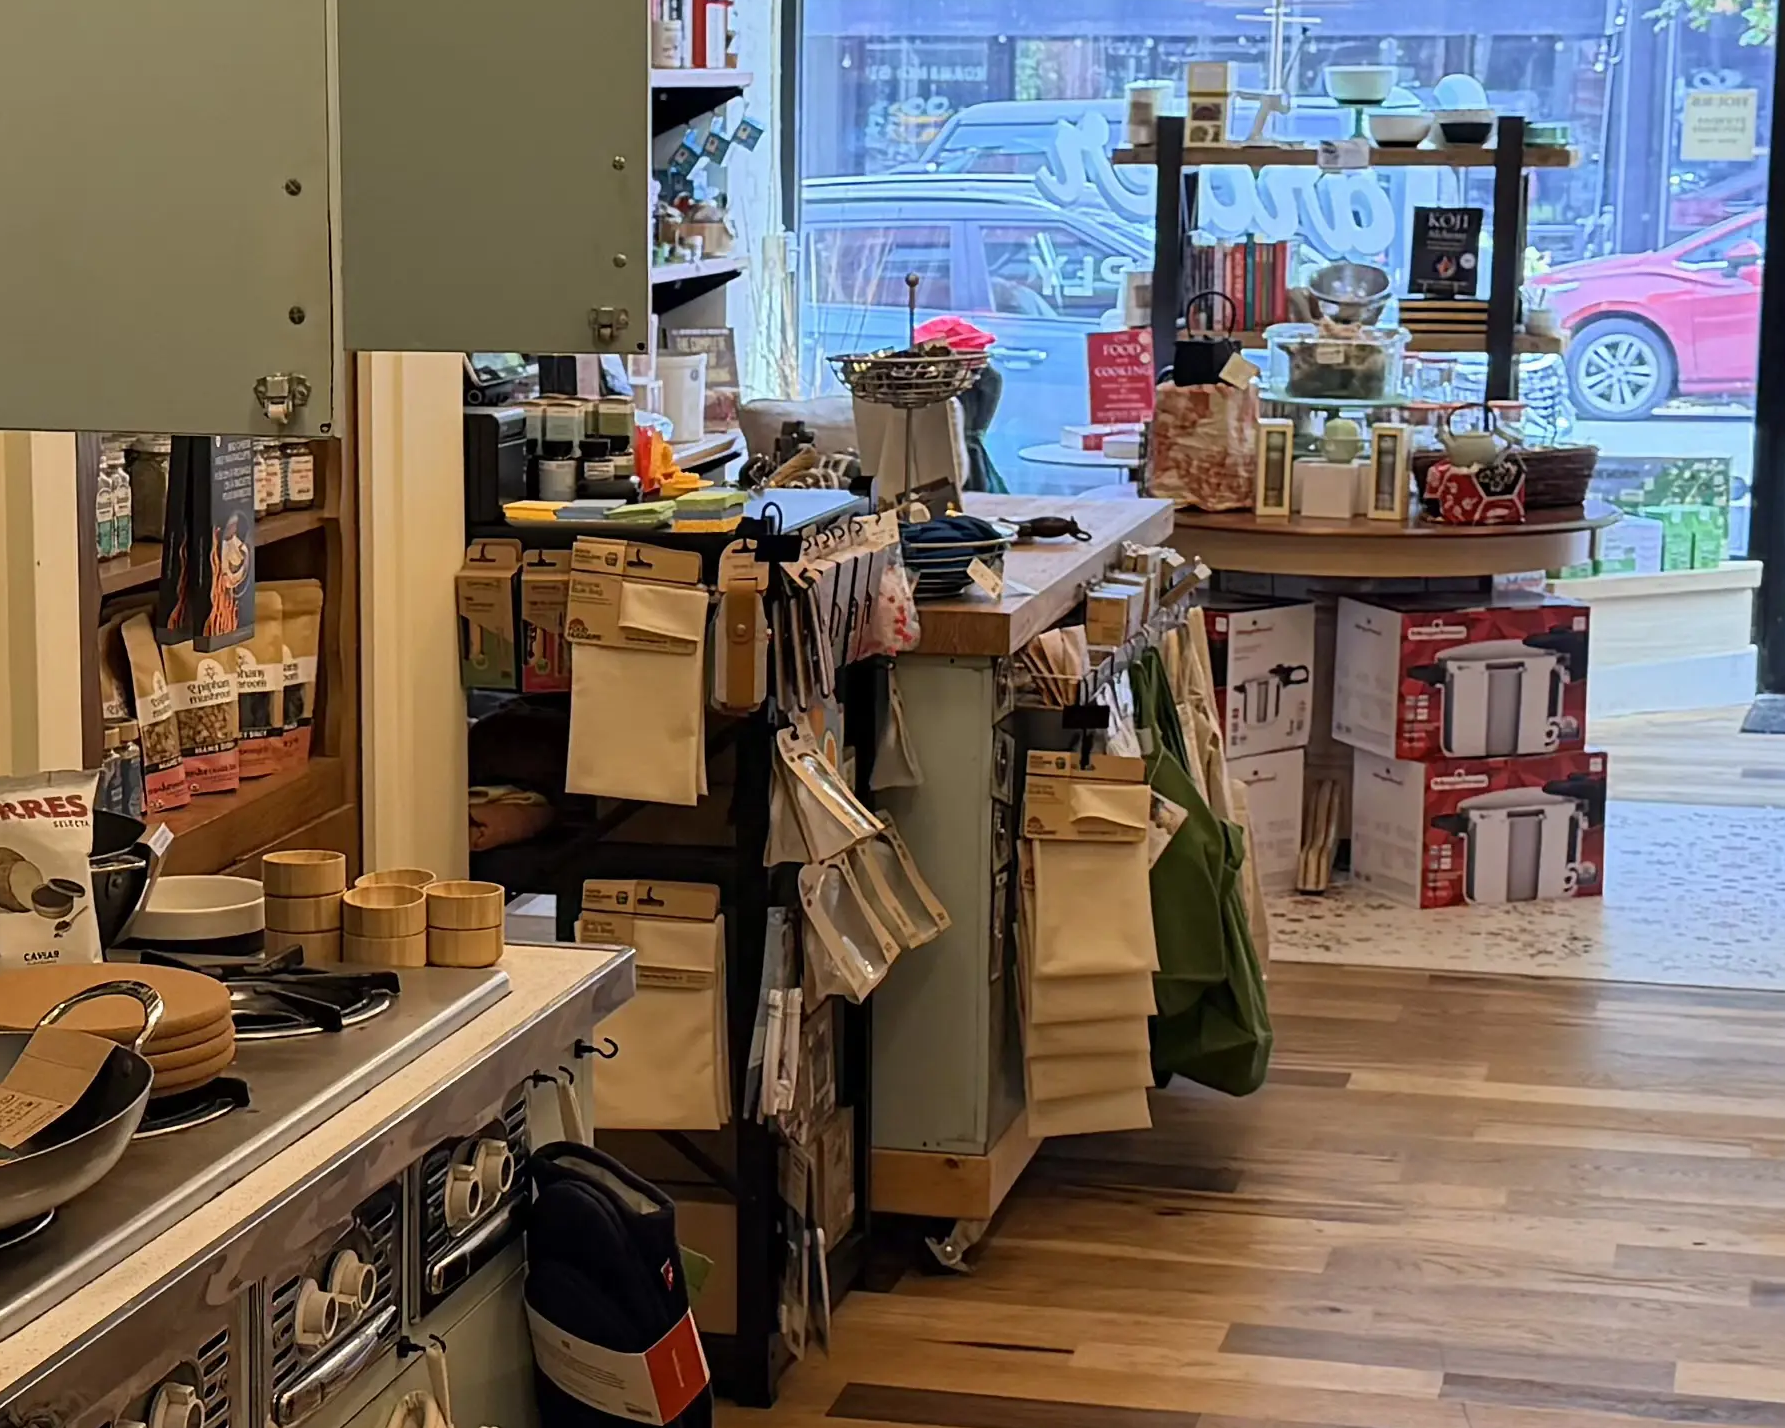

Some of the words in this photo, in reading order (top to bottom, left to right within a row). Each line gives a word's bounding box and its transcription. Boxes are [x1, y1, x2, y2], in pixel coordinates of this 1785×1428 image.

[1428, 212, 1468, 230] KOJI
[1102, 344, 1141, 356] FOOD
[186, 679, 230, 696] epiphan
[24, 950, 59, 961] CAVIAR
